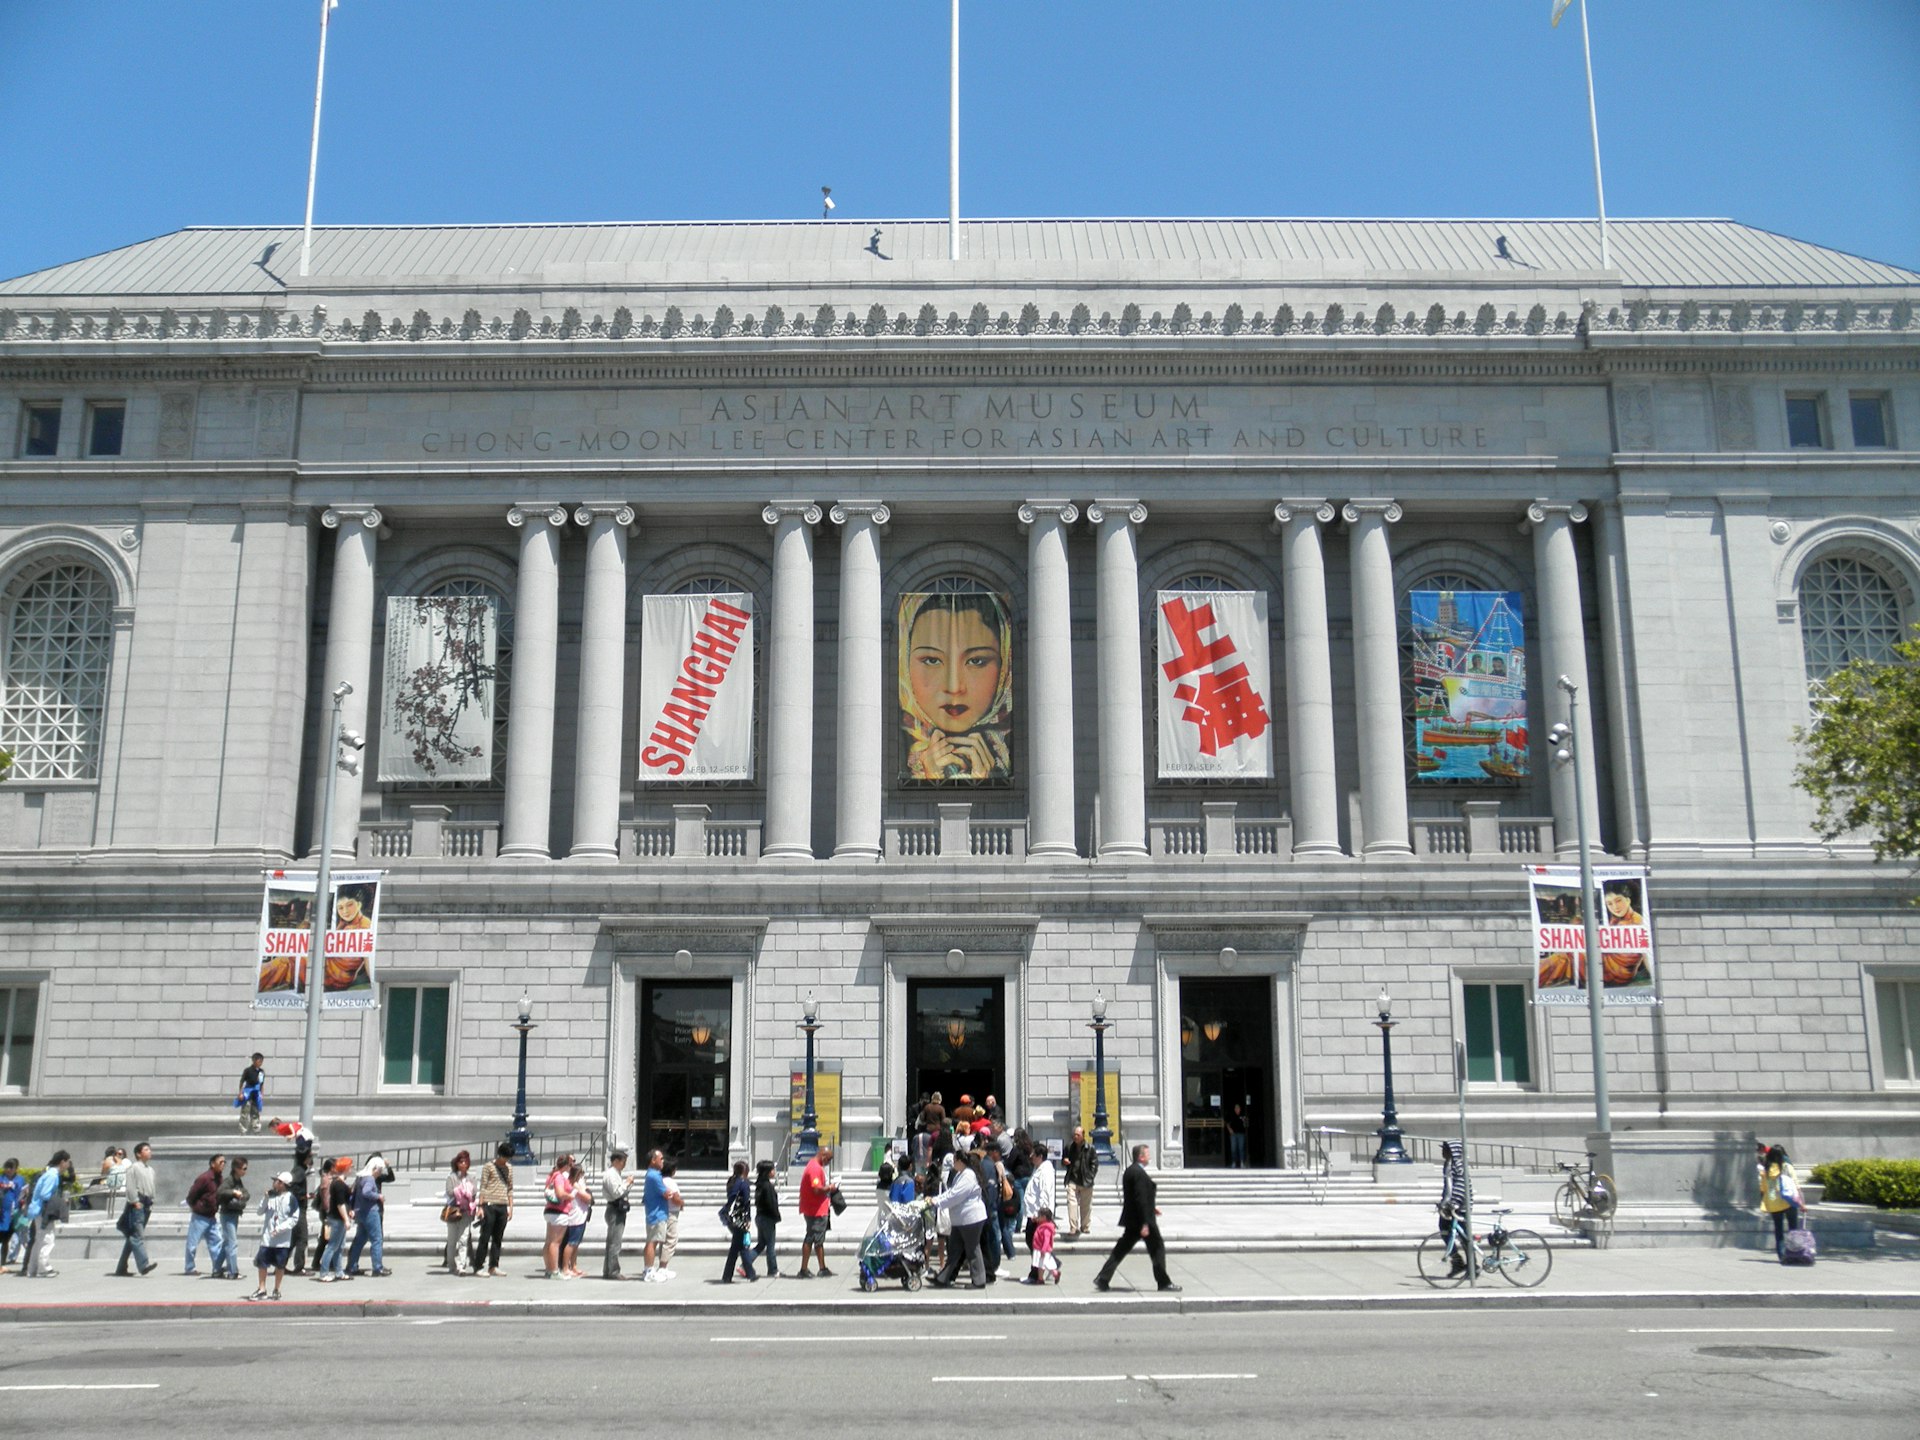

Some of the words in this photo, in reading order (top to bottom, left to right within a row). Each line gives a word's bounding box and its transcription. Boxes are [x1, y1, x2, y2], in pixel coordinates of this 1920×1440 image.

[710, 395, 849, 422] ASIAN
[873, 394, 963, 421] ART
[984, 392, 1203, 420] MUSEUM
[421, 429, 688, 454] CHONG-MOON
[711, 429, 765, 451] LEE
[786, 428, 923, 451] CENTER
[943, 428, 1009, 450] FOR
[1026, 427, 1133, 449] ASIAN
[1151, 427, 1214, 448] ART
[1232, 427, 1306, 448] AND
[1326, 427, 1488, 448] CULTURE
[641, 598, 752, 775] SHANGHAI
[690, 765, 706, 774] FEB
[256, 999, 285, 1007] ASIAN
[287, 999, 304, 1008] ART
[327, 999, 371, 1007] MUSEUM
[1538, 994, 1567, 1003] ASIAN
[1569, 995, 1586, 1003] ART
[1607, 994, 1652, 1003] MUSEUM
